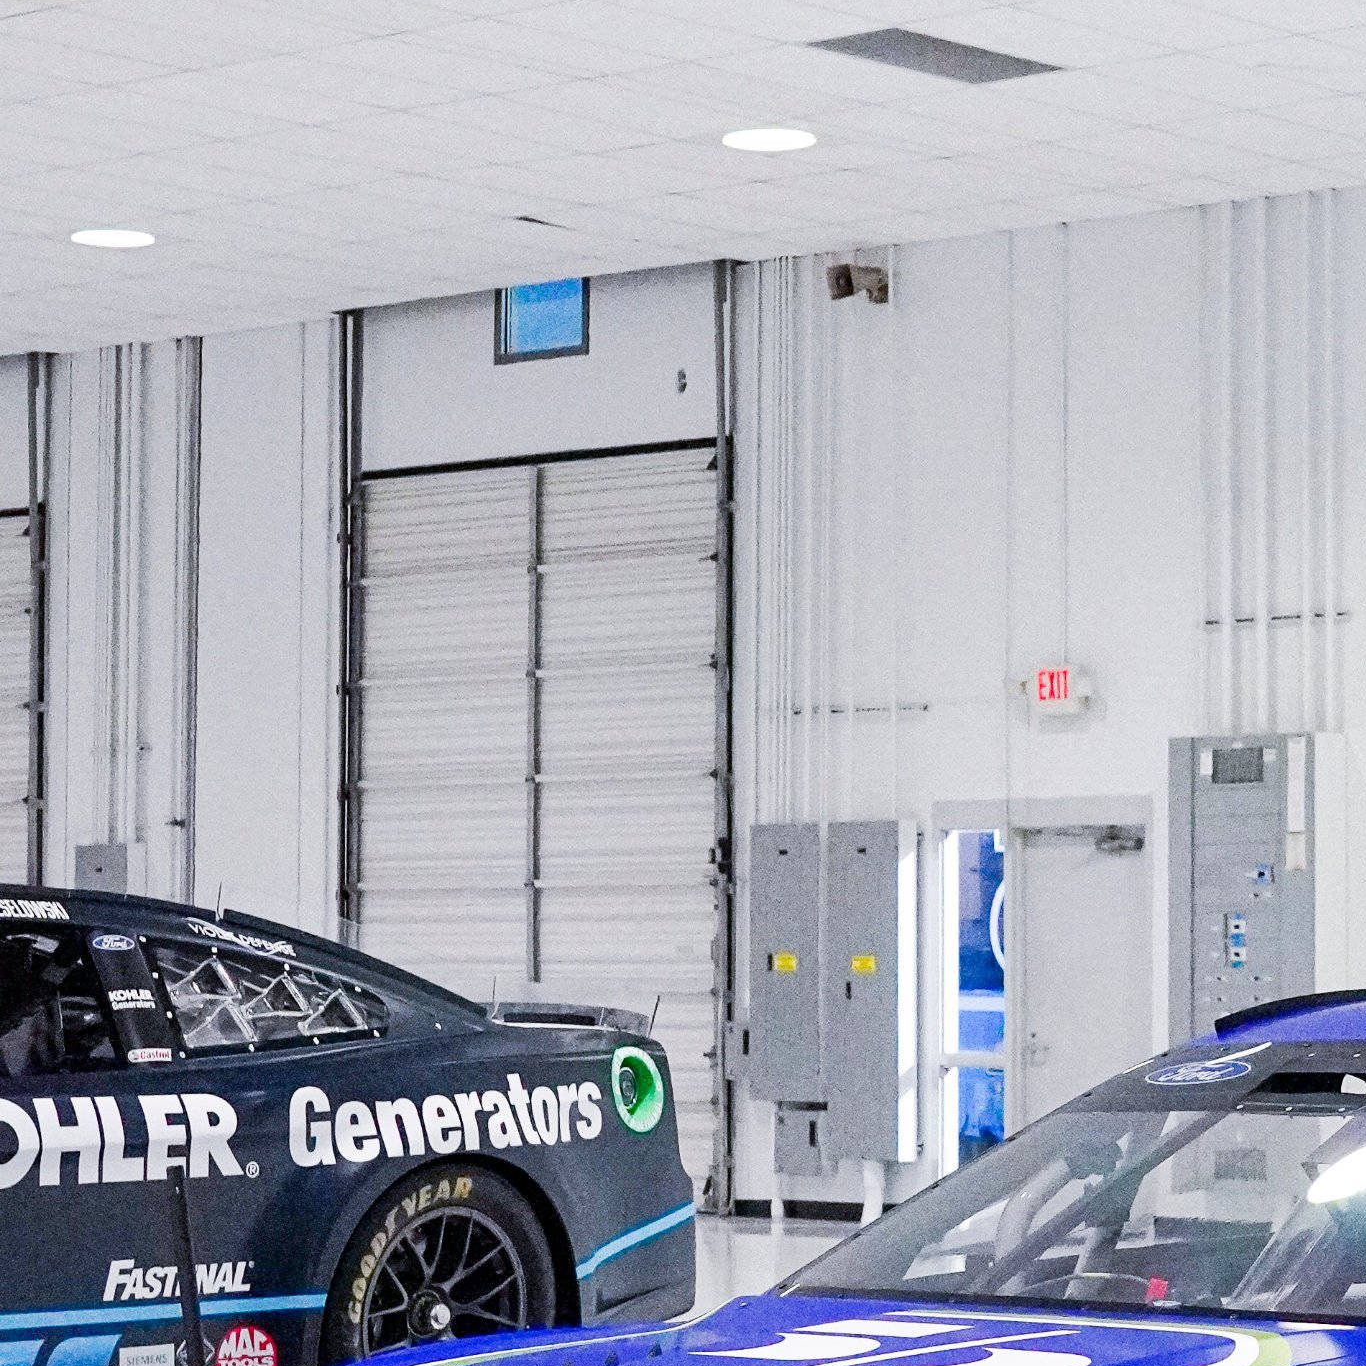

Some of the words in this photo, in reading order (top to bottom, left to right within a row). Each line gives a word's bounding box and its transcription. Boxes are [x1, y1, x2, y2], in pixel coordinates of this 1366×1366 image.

[1037, 669, 1069, 700] EXIT
[0, 899, 70, 920] SELOWSKI
[108, 989, 154, 1002] KOHLER
[289, 1072, 602, 1167] Generators
[102, 1259, 251, 1302] FASTNAL
[221, 1327, 274, 1357] MAC
[125, 1353, 168, 1366] SIEMENS
